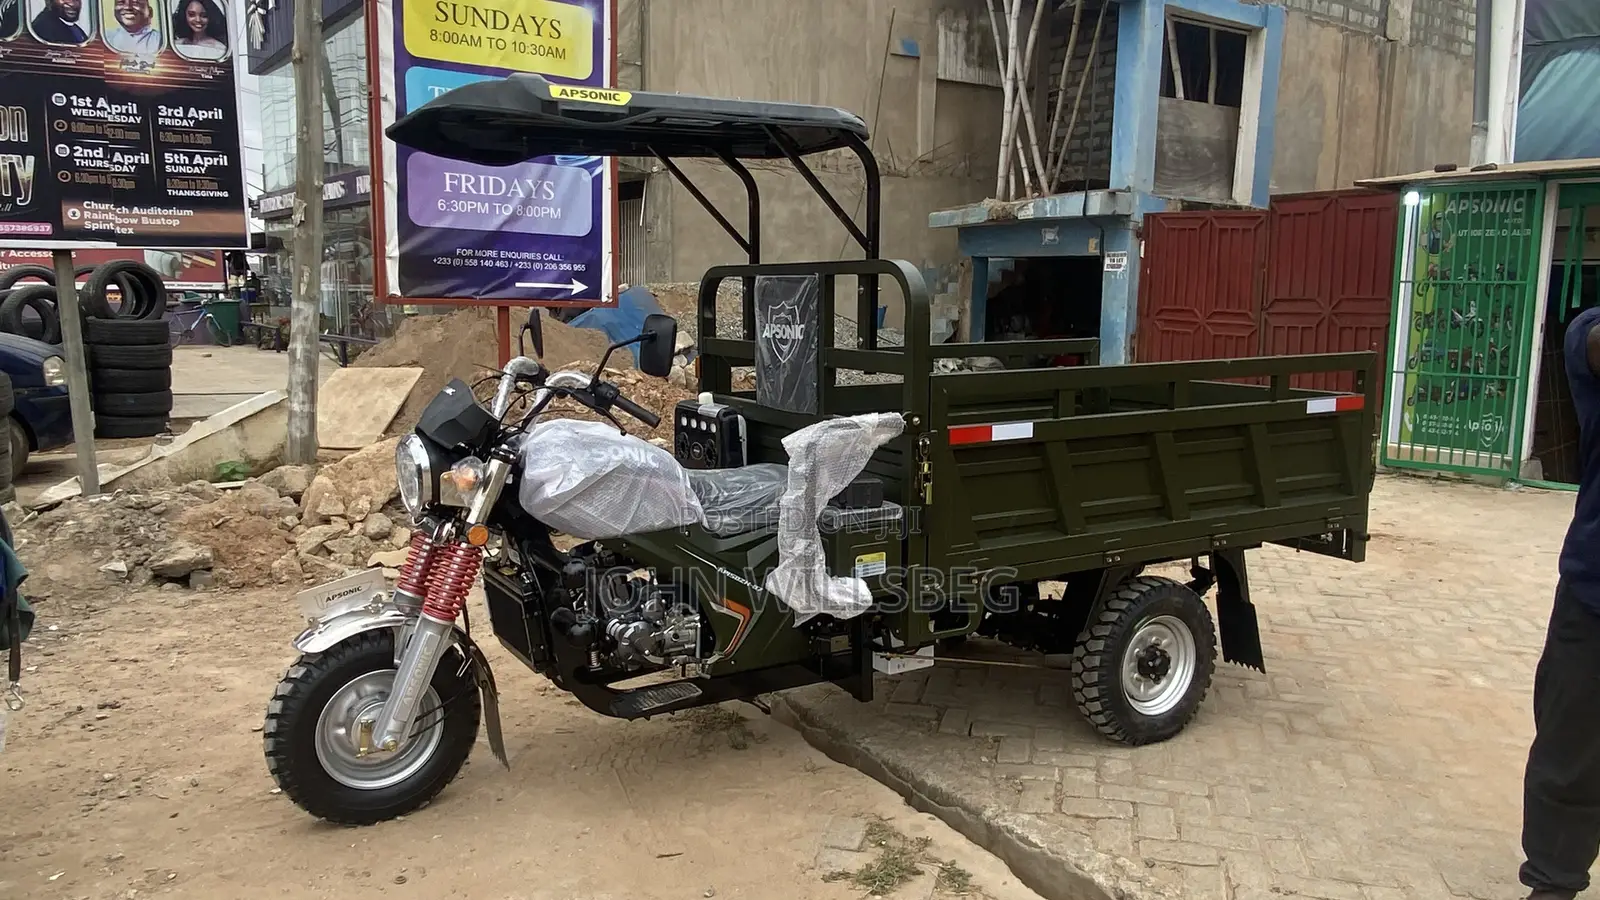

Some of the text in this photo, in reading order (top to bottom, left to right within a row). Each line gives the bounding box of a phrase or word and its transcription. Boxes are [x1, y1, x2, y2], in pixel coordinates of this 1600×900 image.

[434, 1, 561, 40] SUNDAYS
[429, 29, 566, 60] 8:00AM TO 10:30AM
[559, 88, 621, 102] APSONIC
[70, 95, 138, 115] 1st April
[157, 105, 223, 121] 3rd April
[158, 117, 195, 127] FRIDAY
[72, 145, 150, 165] 2nd April
[164, 152, 228, 167] 5th April
[165, 165, 206, 174] SUNDAY
[167, 189, 229, 198] THANKSGIVING
[443, 172, 555, 200] FRIDAYS
[132, 206, 194, 217] Auditorium
[438, 199, 561, 220] 6:30PM TO 8:00PM
[1445, 197, 1526, 215] APSONIC
[141, 216, 180, 227] Bustop
[456, 248, 473, 257] FOR
[475, 250, 498, 258] MORE
[500, 250, 541, 260] ENQUIRIES
[453, 258, 463, 267] (0)
[533, 262, 543, 271] (0)
[762, 323, 804, 339] APSONIC
[325, 585, 363, 603] APSONIC
